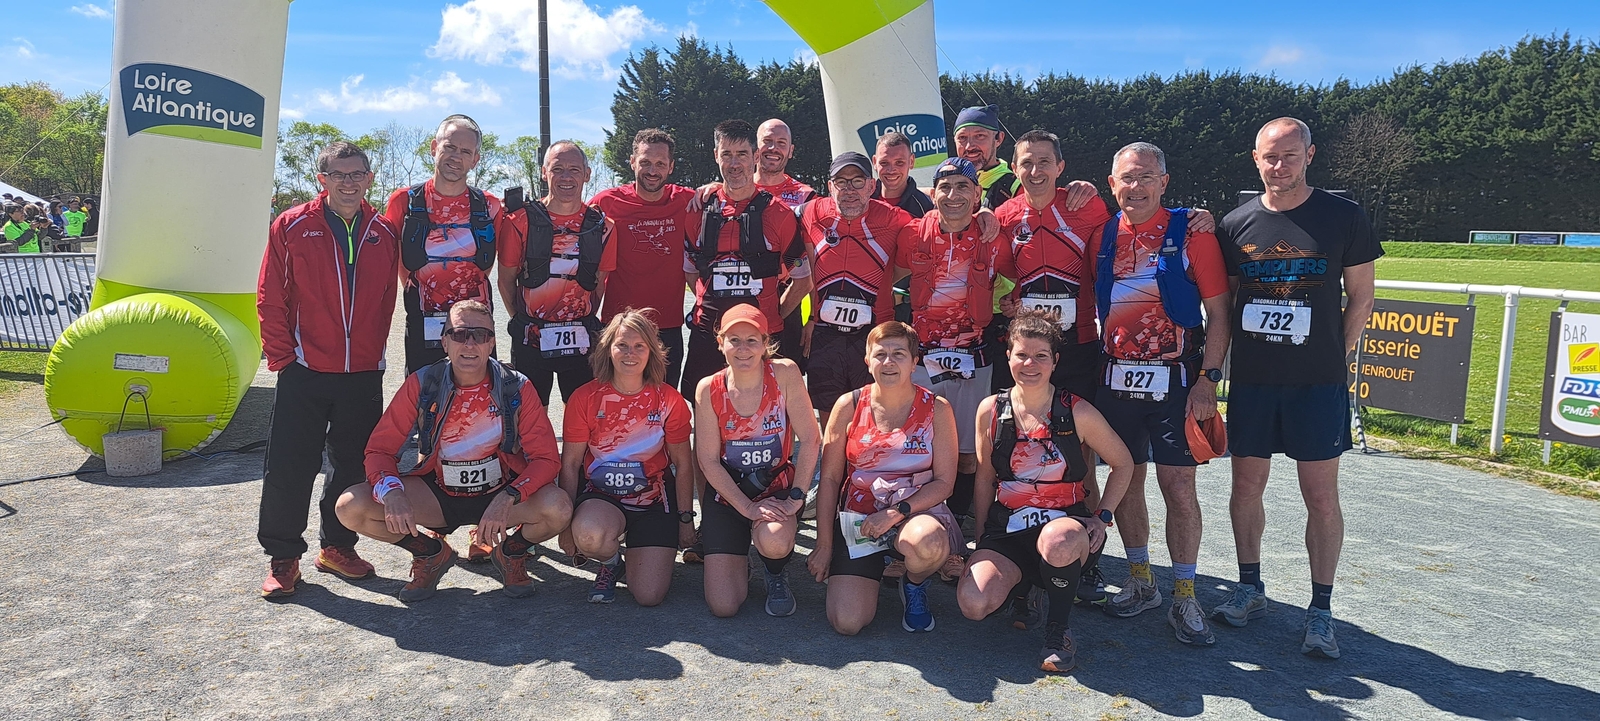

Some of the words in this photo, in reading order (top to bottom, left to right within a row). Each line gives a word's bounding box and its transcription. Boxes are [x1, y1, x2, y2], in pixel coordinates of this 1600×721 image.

[134, 69, 193, 95] Loire
[131, 92, 256, 130] Atlantique
[874, 122, 917, 140] Loire
[910, 135, 947, 154] ntique
[1240, 259, 1328, 278] TEMPLIERS
[726, 272, 751, 287] 819
[834, 306, 859, 324] 710
[1260, 311, 1294, 331] 732
[554, 331, 577, 347] 781
[1265, 334, 1283, 342] 24KM
[1563, 323, 1588, 342] BAR
[1363, 334, 1421, 359] isserie
[935, 356, 962, 370] 702
[1572, 365, 1598, 373] PRESSE
[1124, 371, 1155, 388] 827
[1562, 379, 1594, 396] FDJ
[1562, 404, 1588, 417] PMU
[763, 420, 782, 431] UAC
[903, 440, 927, 450] UAC
[741, 449, 772, 466] 368
[459, 468, 487, 485] 821
[604, 472, 635, 487] 383
